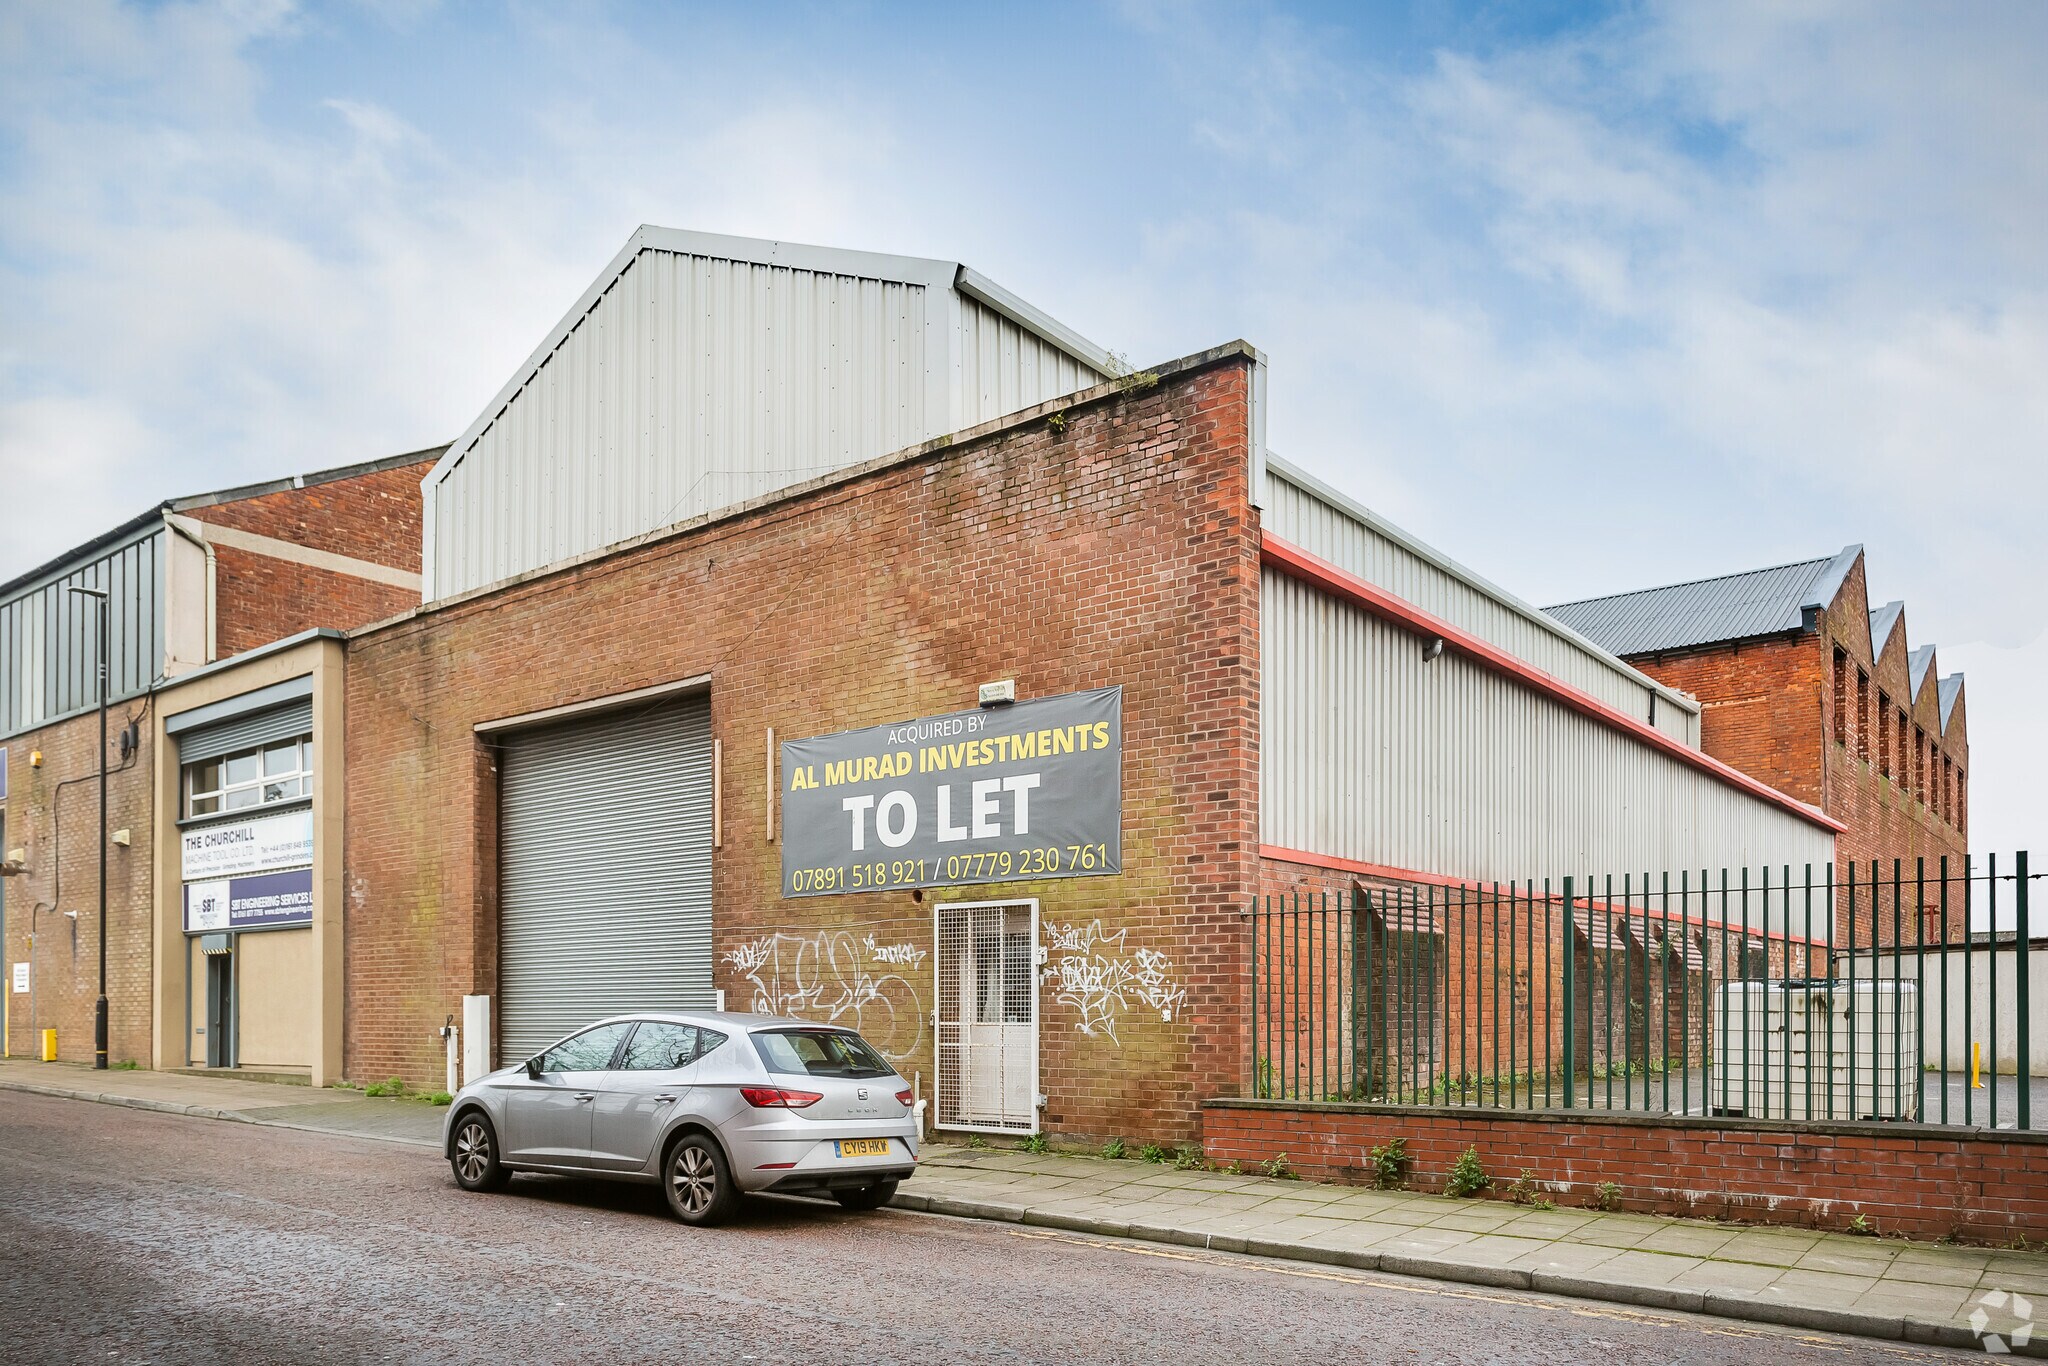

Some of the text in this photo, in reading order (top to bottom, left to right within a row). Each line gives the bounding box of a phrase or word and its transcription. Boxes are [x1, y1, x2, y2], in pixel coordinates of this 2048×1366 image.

[887, 715, 988, 745] ACQUIRED BY
[791, 721, 1110, 791] AL MURAD INVESTMENTS
[842, 773, 1041, 851] TO LET
[186, 827, 254, 850] THE CHURCHILL
[792, 867, 845, 892] 07891
[852, 863, 886, 887] 518
[892, 860, 925, 884] 921
[947, 851, 1012, 879] 07779
[1018, 847, 1059, 874] 230
[1067, 843, 1107, 870] 761
[202, 898, 215, 912] SBT
[241, 895, 280, 909] ENGINEERING
[280, 892, 308, 905] SERVICES
[844, 1140, 867, 1154] CY19
